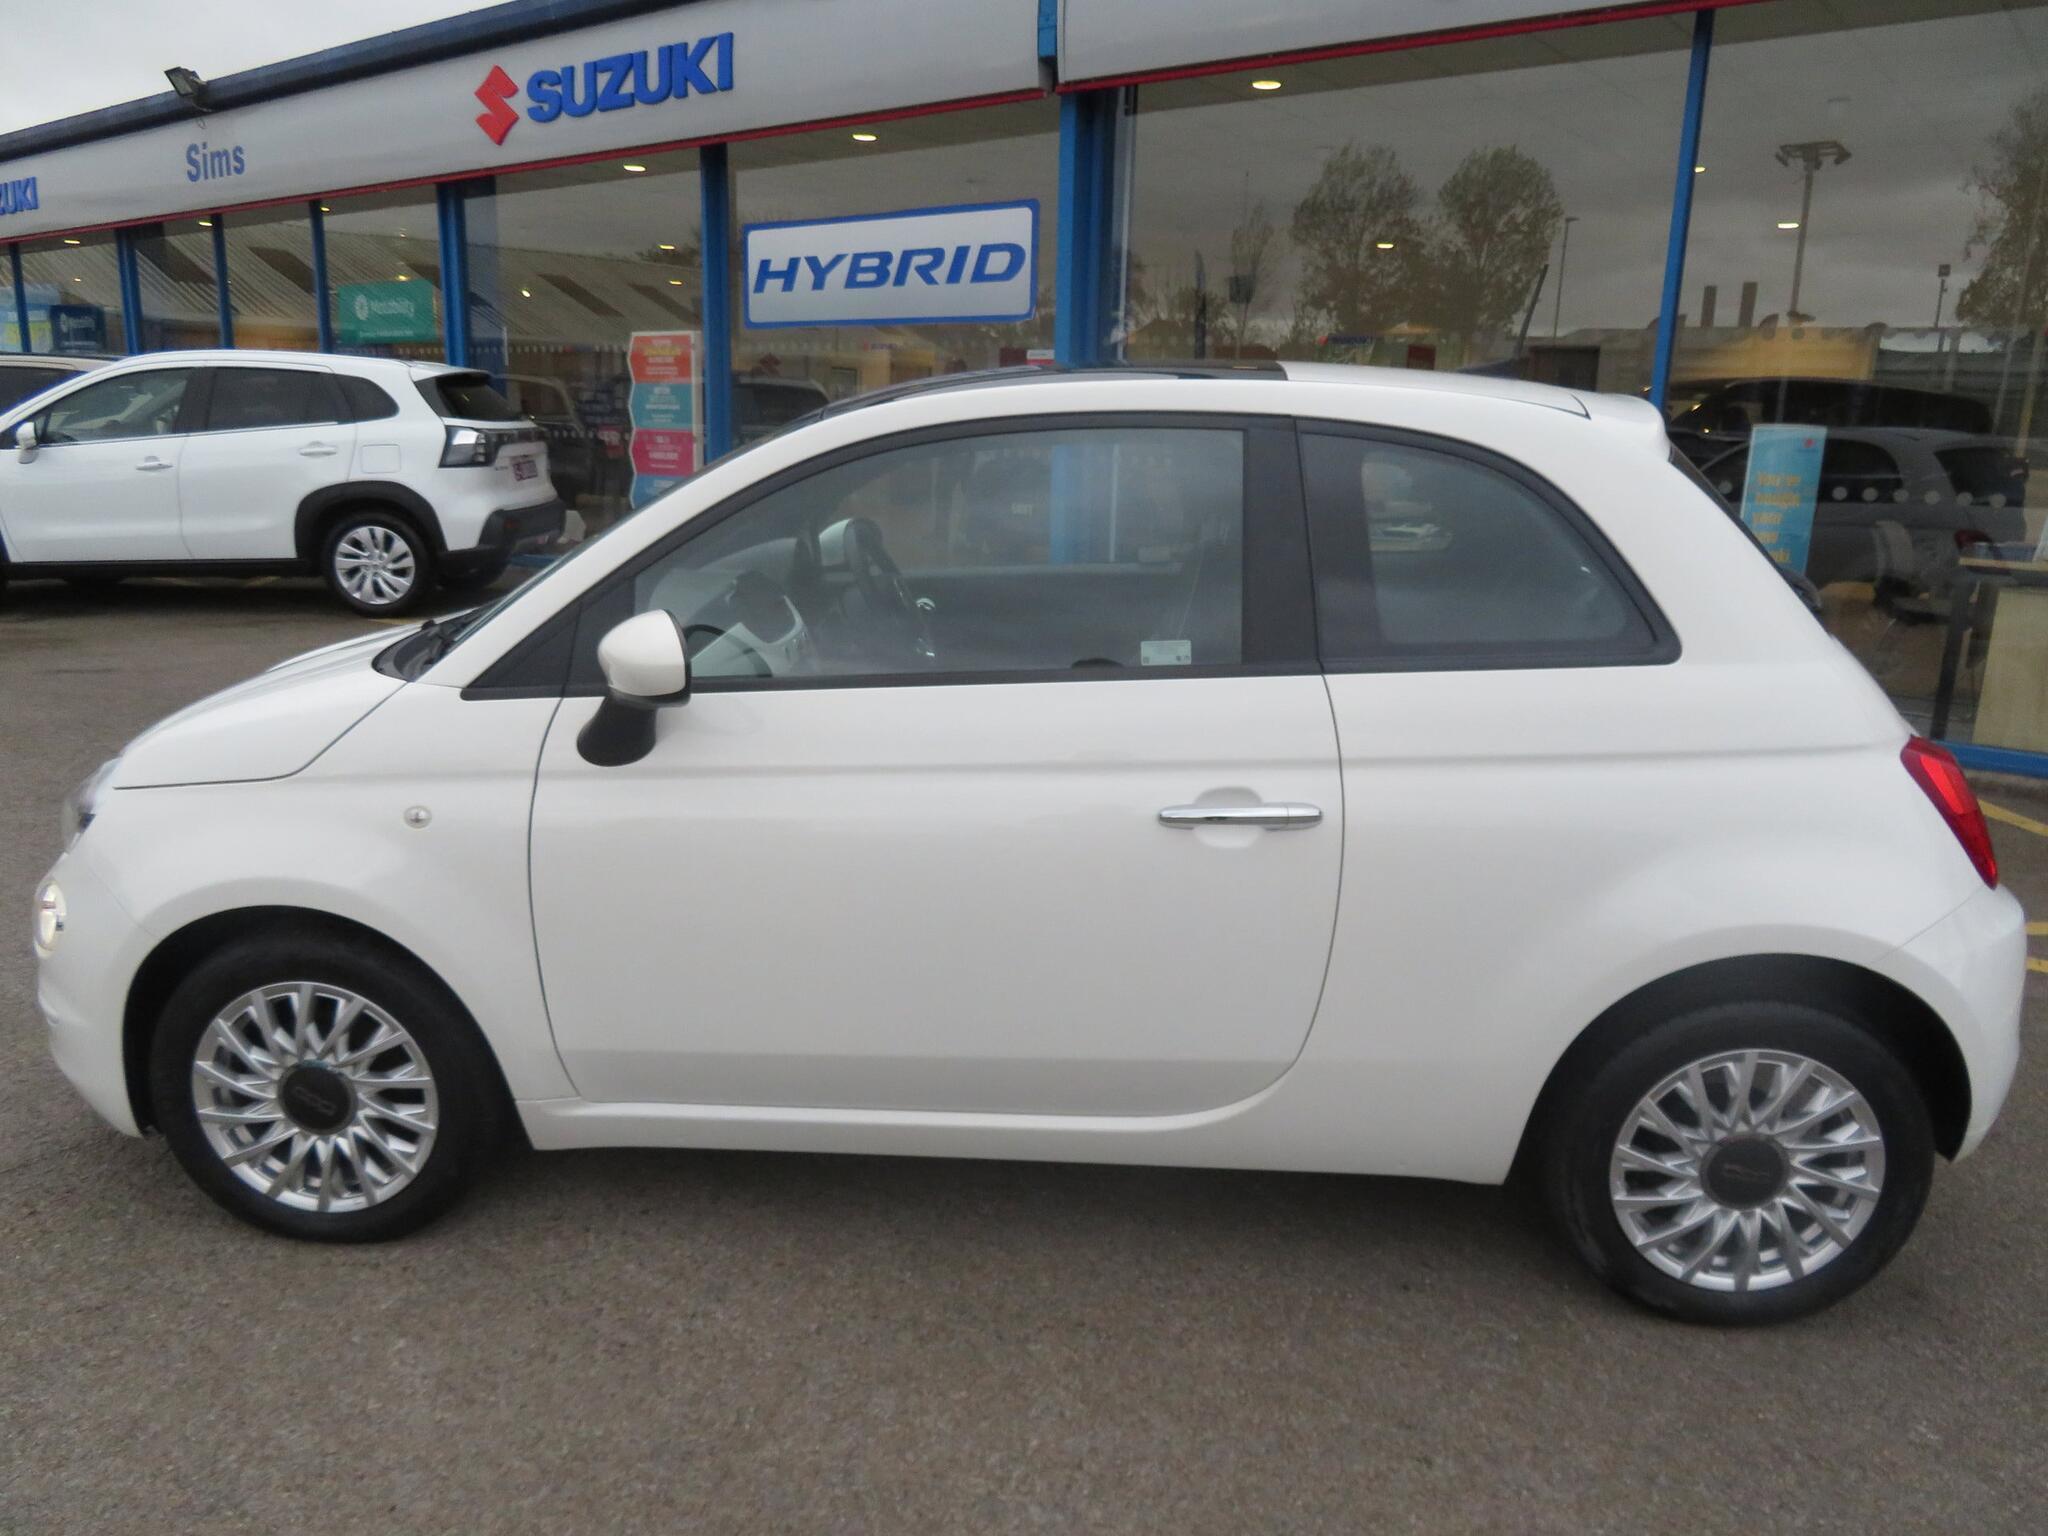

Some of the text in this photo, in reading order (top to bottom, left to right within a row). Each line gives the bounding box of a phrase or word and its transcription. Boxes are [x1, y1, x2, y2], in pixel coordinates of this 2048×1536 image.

[527, 32, 734, 123] SUZUKI
[186, 143, 245, 182] Sims
[753, 243, 1026, 293] HYBRID
